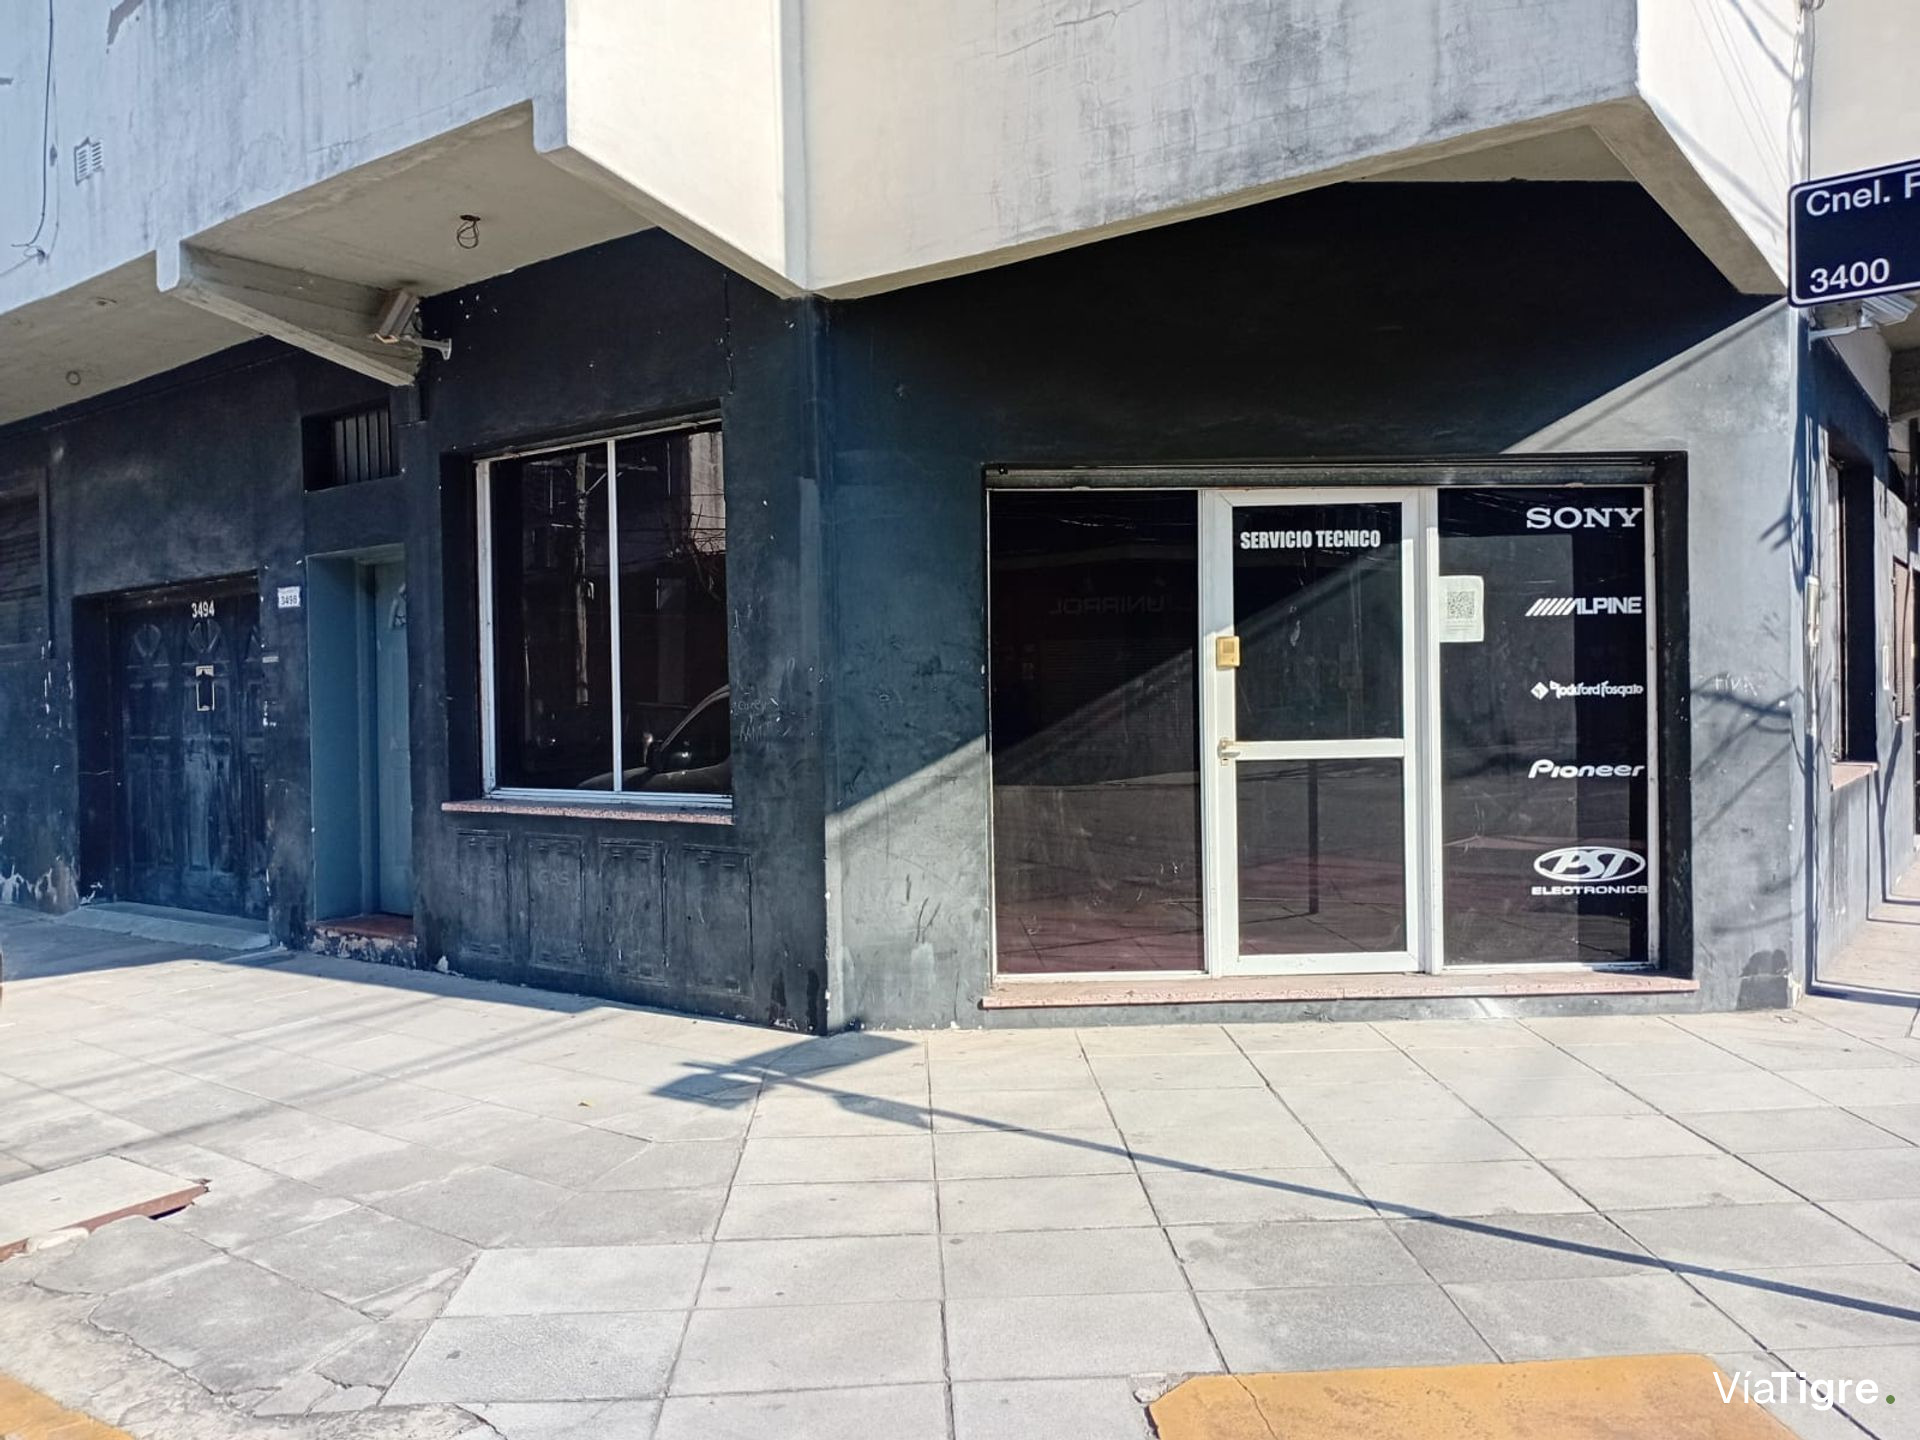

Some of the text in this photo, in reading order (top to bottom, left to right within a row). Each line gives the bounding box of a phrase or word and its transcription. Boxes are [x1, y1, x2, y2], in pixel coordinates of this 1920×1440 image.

[1806, 179, 1890, 217] Cnel.
[1809, 258, 1890, 293] 3400
[1526, 507, 1643, 529] SONY
[1240, 530, 1381, 549] SERVICIO TECNICO
[191, 600, 215, 618] 3494
[1528, 759, 1644, 778] Pioneer
[1531, 885, 1649, 896] ELECTRONICS
